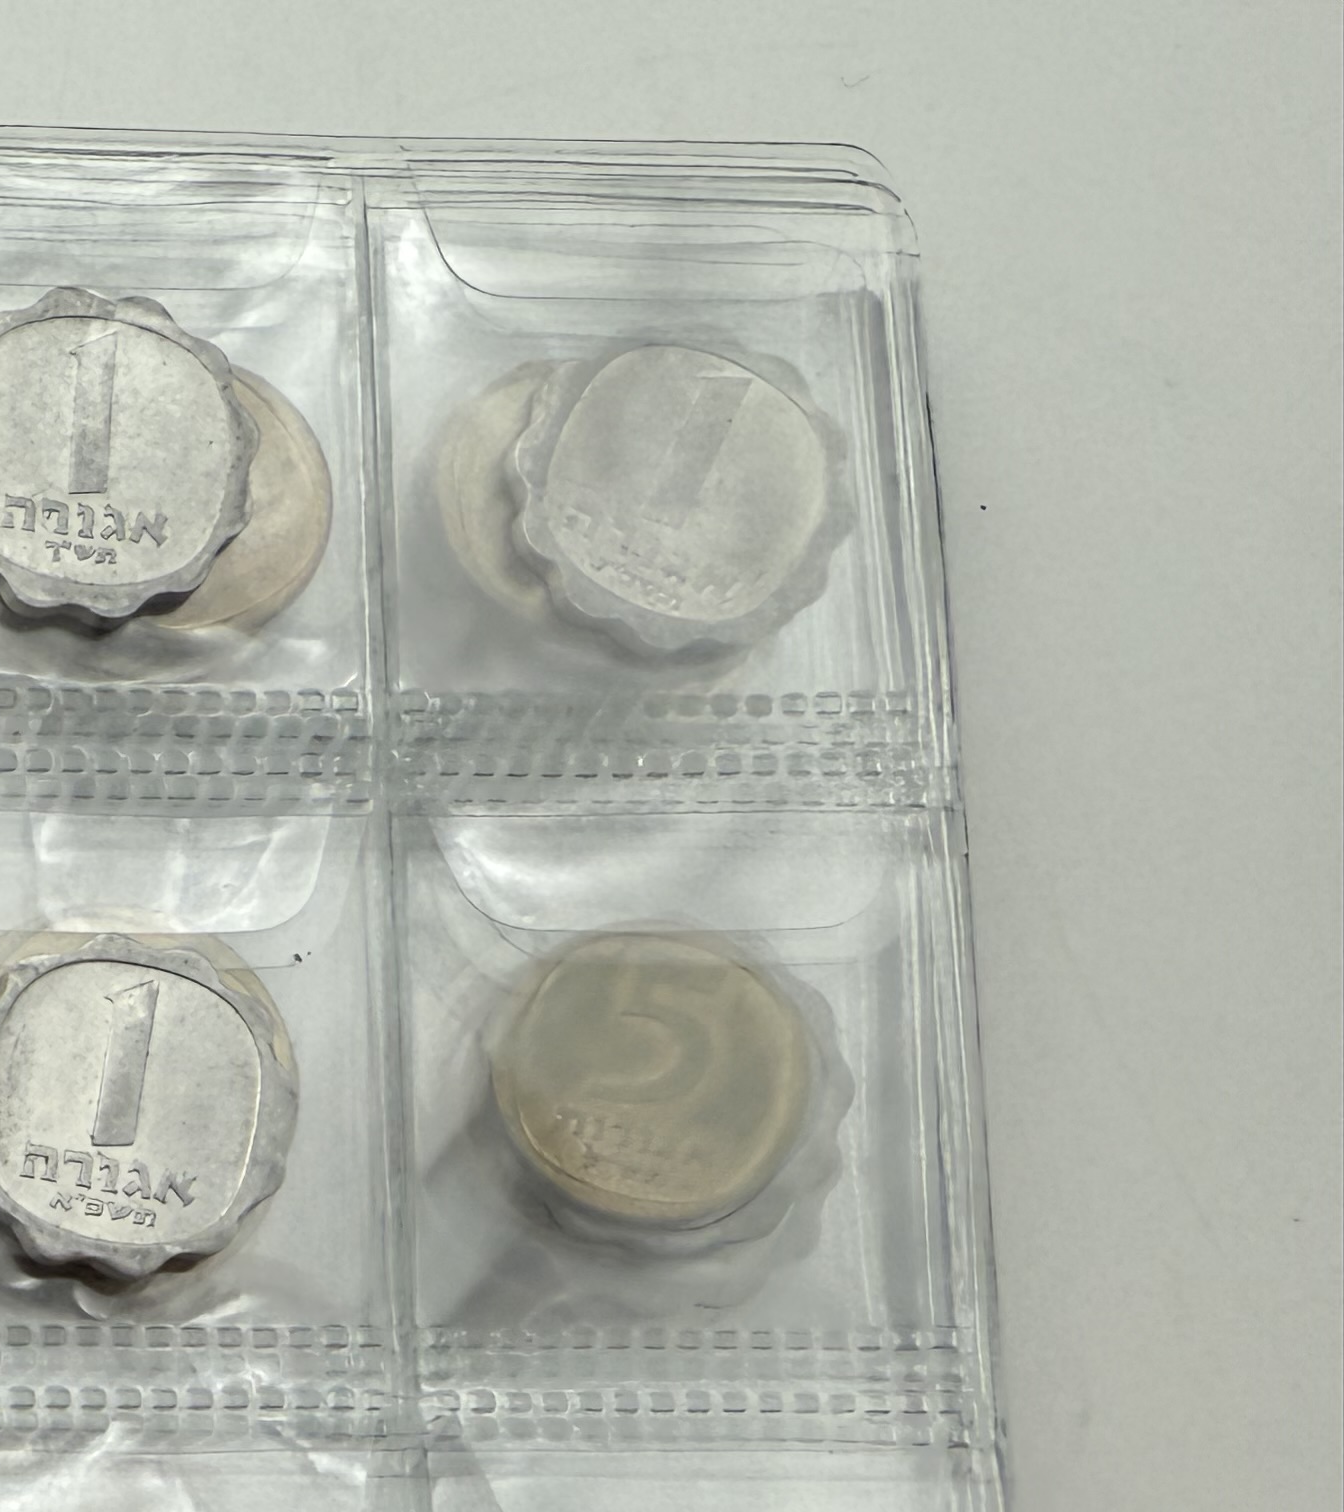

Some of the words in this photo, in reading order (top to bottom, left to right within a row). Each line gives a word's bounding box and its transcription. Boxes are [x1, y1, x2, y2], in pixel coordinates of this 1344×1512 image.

[68, 330, 119, 495] 1
[0, 493, 170, 548] אגורה
[89, 978, 161, 1147] 1
[19, 1139, 199, 1207] אגורה
